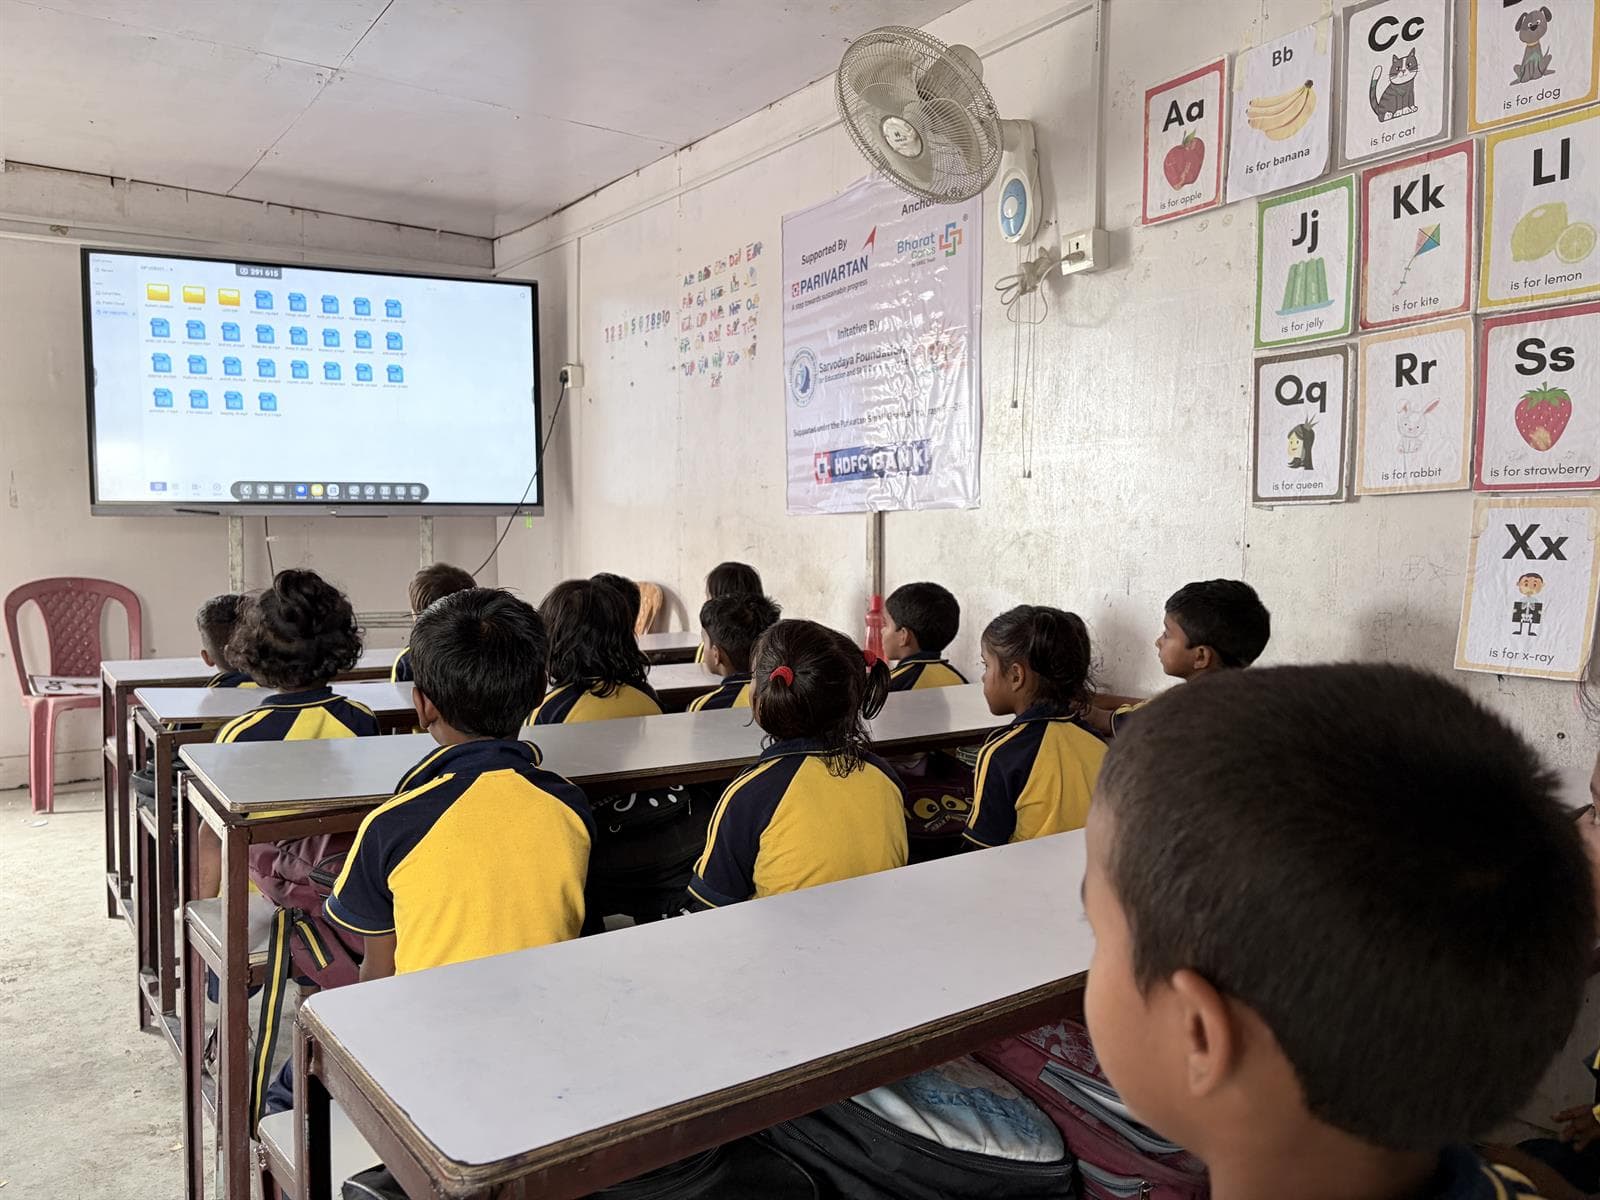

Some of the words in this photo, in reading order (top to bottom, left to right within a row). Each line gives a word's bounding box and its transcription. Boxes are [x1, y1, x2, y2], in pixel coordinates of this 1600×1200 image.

[1367, 15, 1424, 52] Cc
[1272, 46, 1293, 67] Bb
[1503, 100, 1512, 110] is
[1516, 94, 1533, 107] for
[1536, 87, 1561, 101] dog
[1162, 98, 1204, 132] Aa
[1370, 136, 1379, 147] is
[1381, 132, 1397, 144] for
[1398, 126, 1416, 140] cat
[1245, 164, 1254, 175] is
[1256, 158, 1271, 172] for
[1273, 148, 1311, 167] banana
[1532, 137, 1571, 187] Ll
[1160, 200, 1166, 210] is
[1167, 196, 1180, 209] for
[1180, 191, 1202, 206] apple
[1393, 174, 1445, 220] Kk
[1291, 209, 1319, 254] Jj
[801, 241, 837, 265] Supported
[838, 238, 848, 252] By
[897, 232, 936, 254] Bharat
[800, 254, 869, 295] PARIVARTAN
[1509, 279, 1520, 291] is
[1523, 275, 1543, 288] for
[1544, 270, 1582, 286] lemon
[847, 279, 868, 293] progress
[1391, 302, 1401, 313] is
[1402, 299, 1418, 311] for
[1420, 294, 1439, 309] kite
[869, 320, 880, 332] By
[1281, 324, 1288, 334] is
[1291, 320, 1304, 331] for
[1306, 317, 1325, 332] jelly
[819, 356, 855, 373] Sarvodaya
[1514, 337, 1576, 376] Ss
[1394, 352, 1437, 388] Rr
[1275, 374, 1327, 413] Qq
[835, 454, 868, 476] HDFC
[871, 443, 929, 472] BANK
[1381, 470, 1389, 480] is
[1390, 468, 1407, 480] for
[1409, 466, 1442, 479] rabbit
[1489, 467, 1500, 477] is
[1502, 465, 1521, 477] for
[1523, 463, 1592, 479] strawberry
[1272, 481, 1280, 491] is
[1281, 480, 1294, 491] for
[1296, 480, 1323, 493] queen
[1501, 523, 1569, 561] Xx
[1489, 647, 1499, 658] is
[1501, 648, 1519, 660] for
[1522, 651, 1554, 664] x-ray
